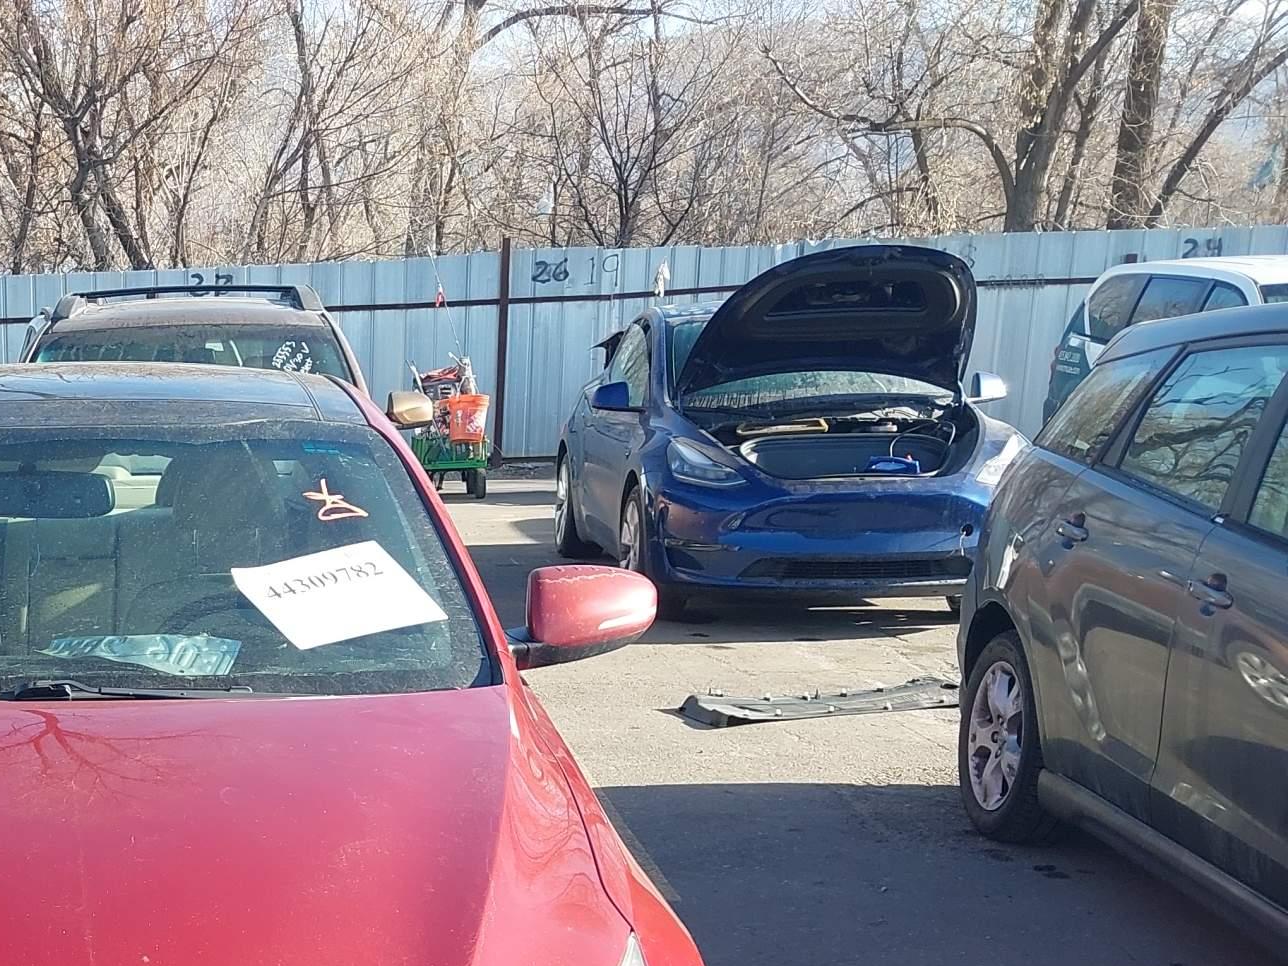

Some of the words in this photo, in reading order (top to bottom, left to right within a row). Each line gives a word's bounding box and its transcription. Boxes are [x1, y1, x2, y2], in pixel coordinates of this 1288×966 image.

[531, 256, 570, 284] 26
[583, 253, 620, 288] 19
[264, 561, 384, 600] 44309782
